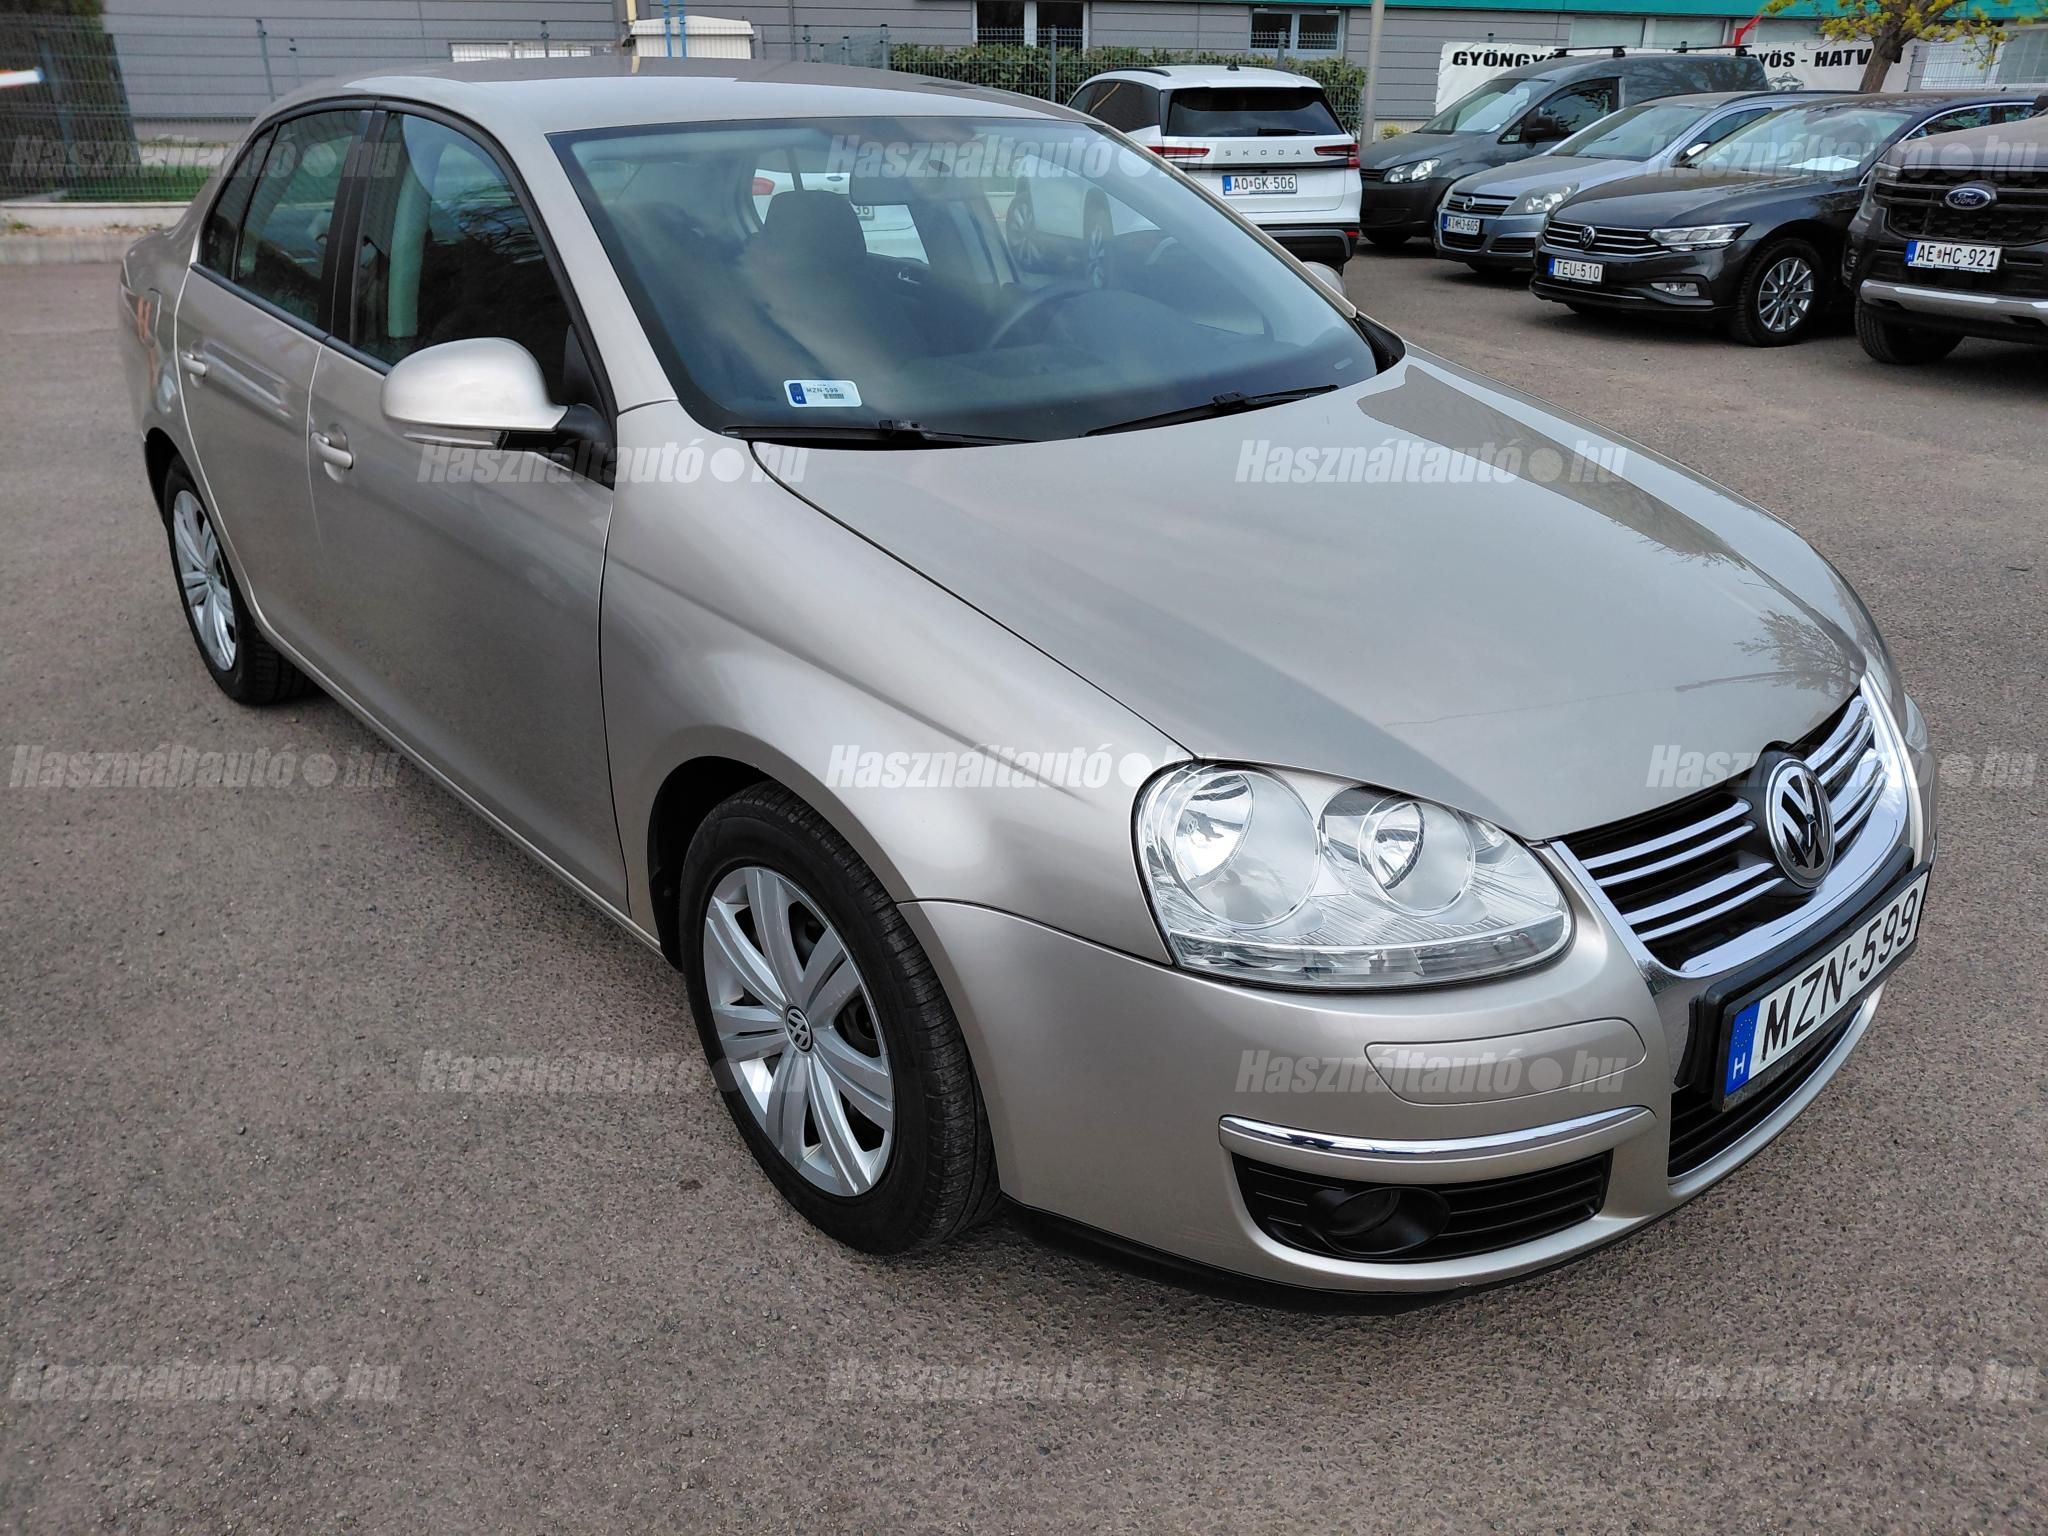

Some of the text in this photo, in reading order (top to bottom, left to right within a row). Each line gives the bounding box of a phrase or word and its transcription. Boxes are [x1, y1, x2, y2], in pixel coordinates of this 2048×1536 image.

[1814, 48, 1904, 67] HATV
[1225, 149, 1301, 157] SKODA
[1556, 260, 1600, 280] TEU-510
[1761, 887, 1919, 1061] MZN-599
